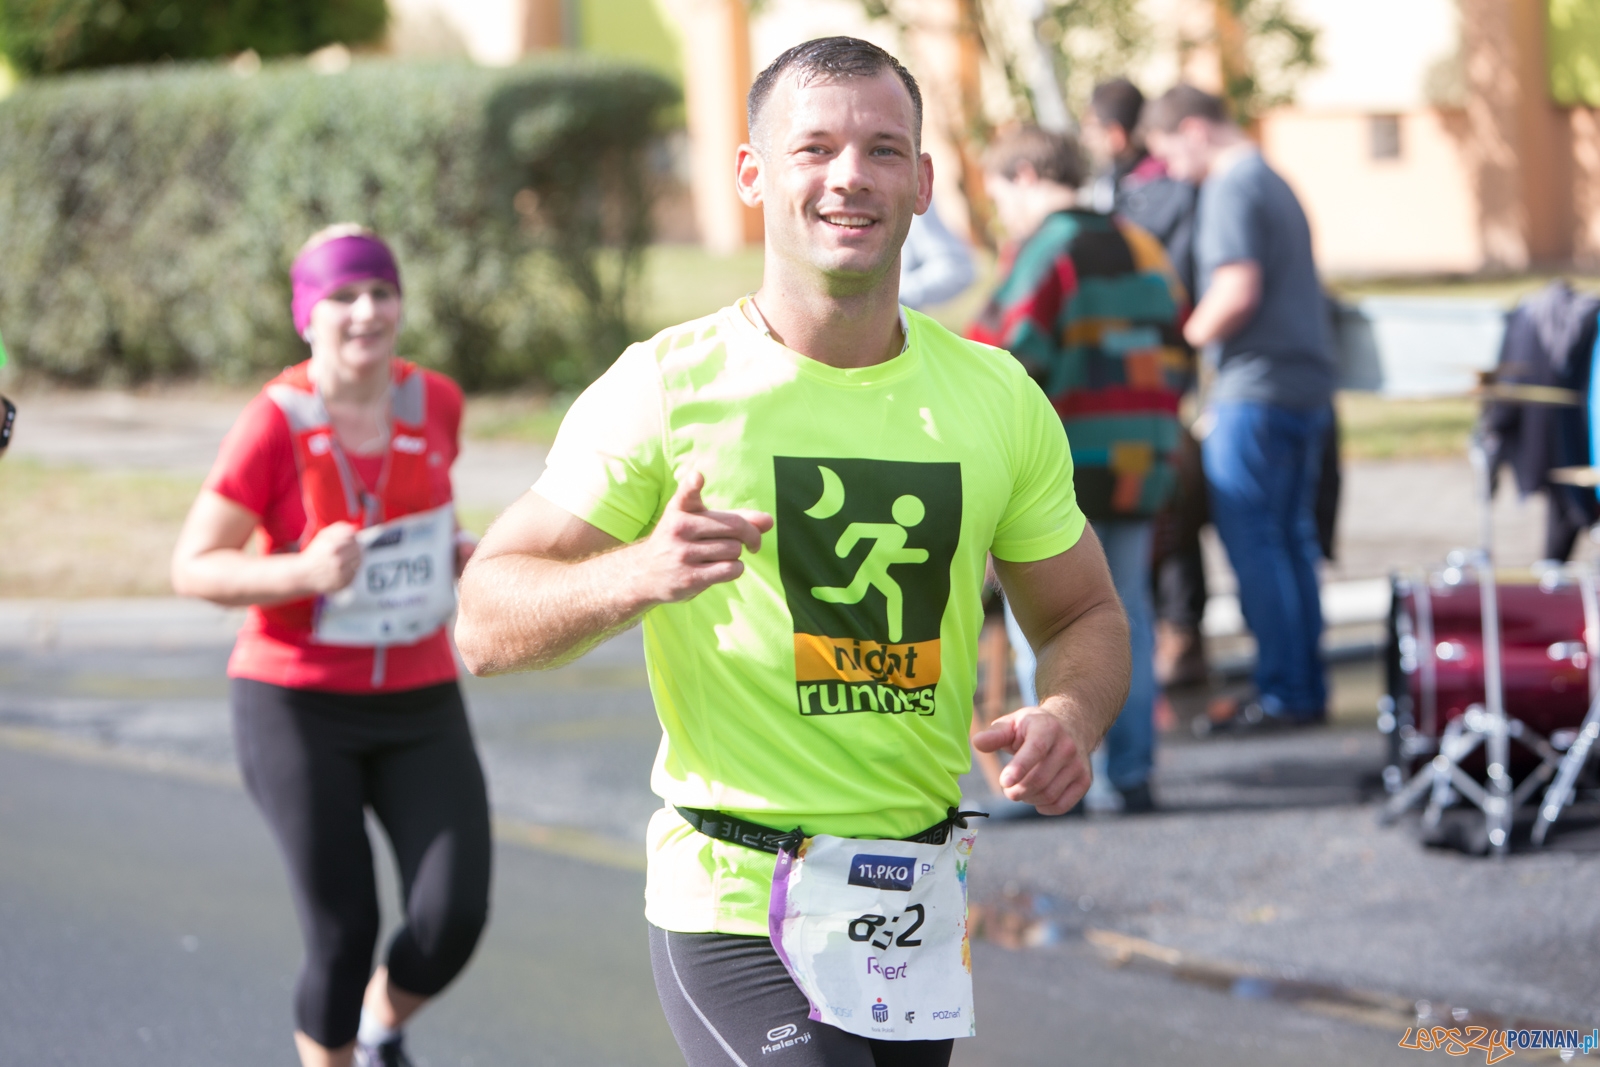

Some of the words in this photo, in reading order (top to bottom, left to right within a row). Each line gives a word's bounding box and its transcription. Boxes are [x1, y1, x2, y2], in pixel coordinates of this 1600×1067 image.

[858, 863, 909, 881] 11.PKO
[867, 956, 908, 980] Rert
[761, 1032, 812, 1055] Kalenji
